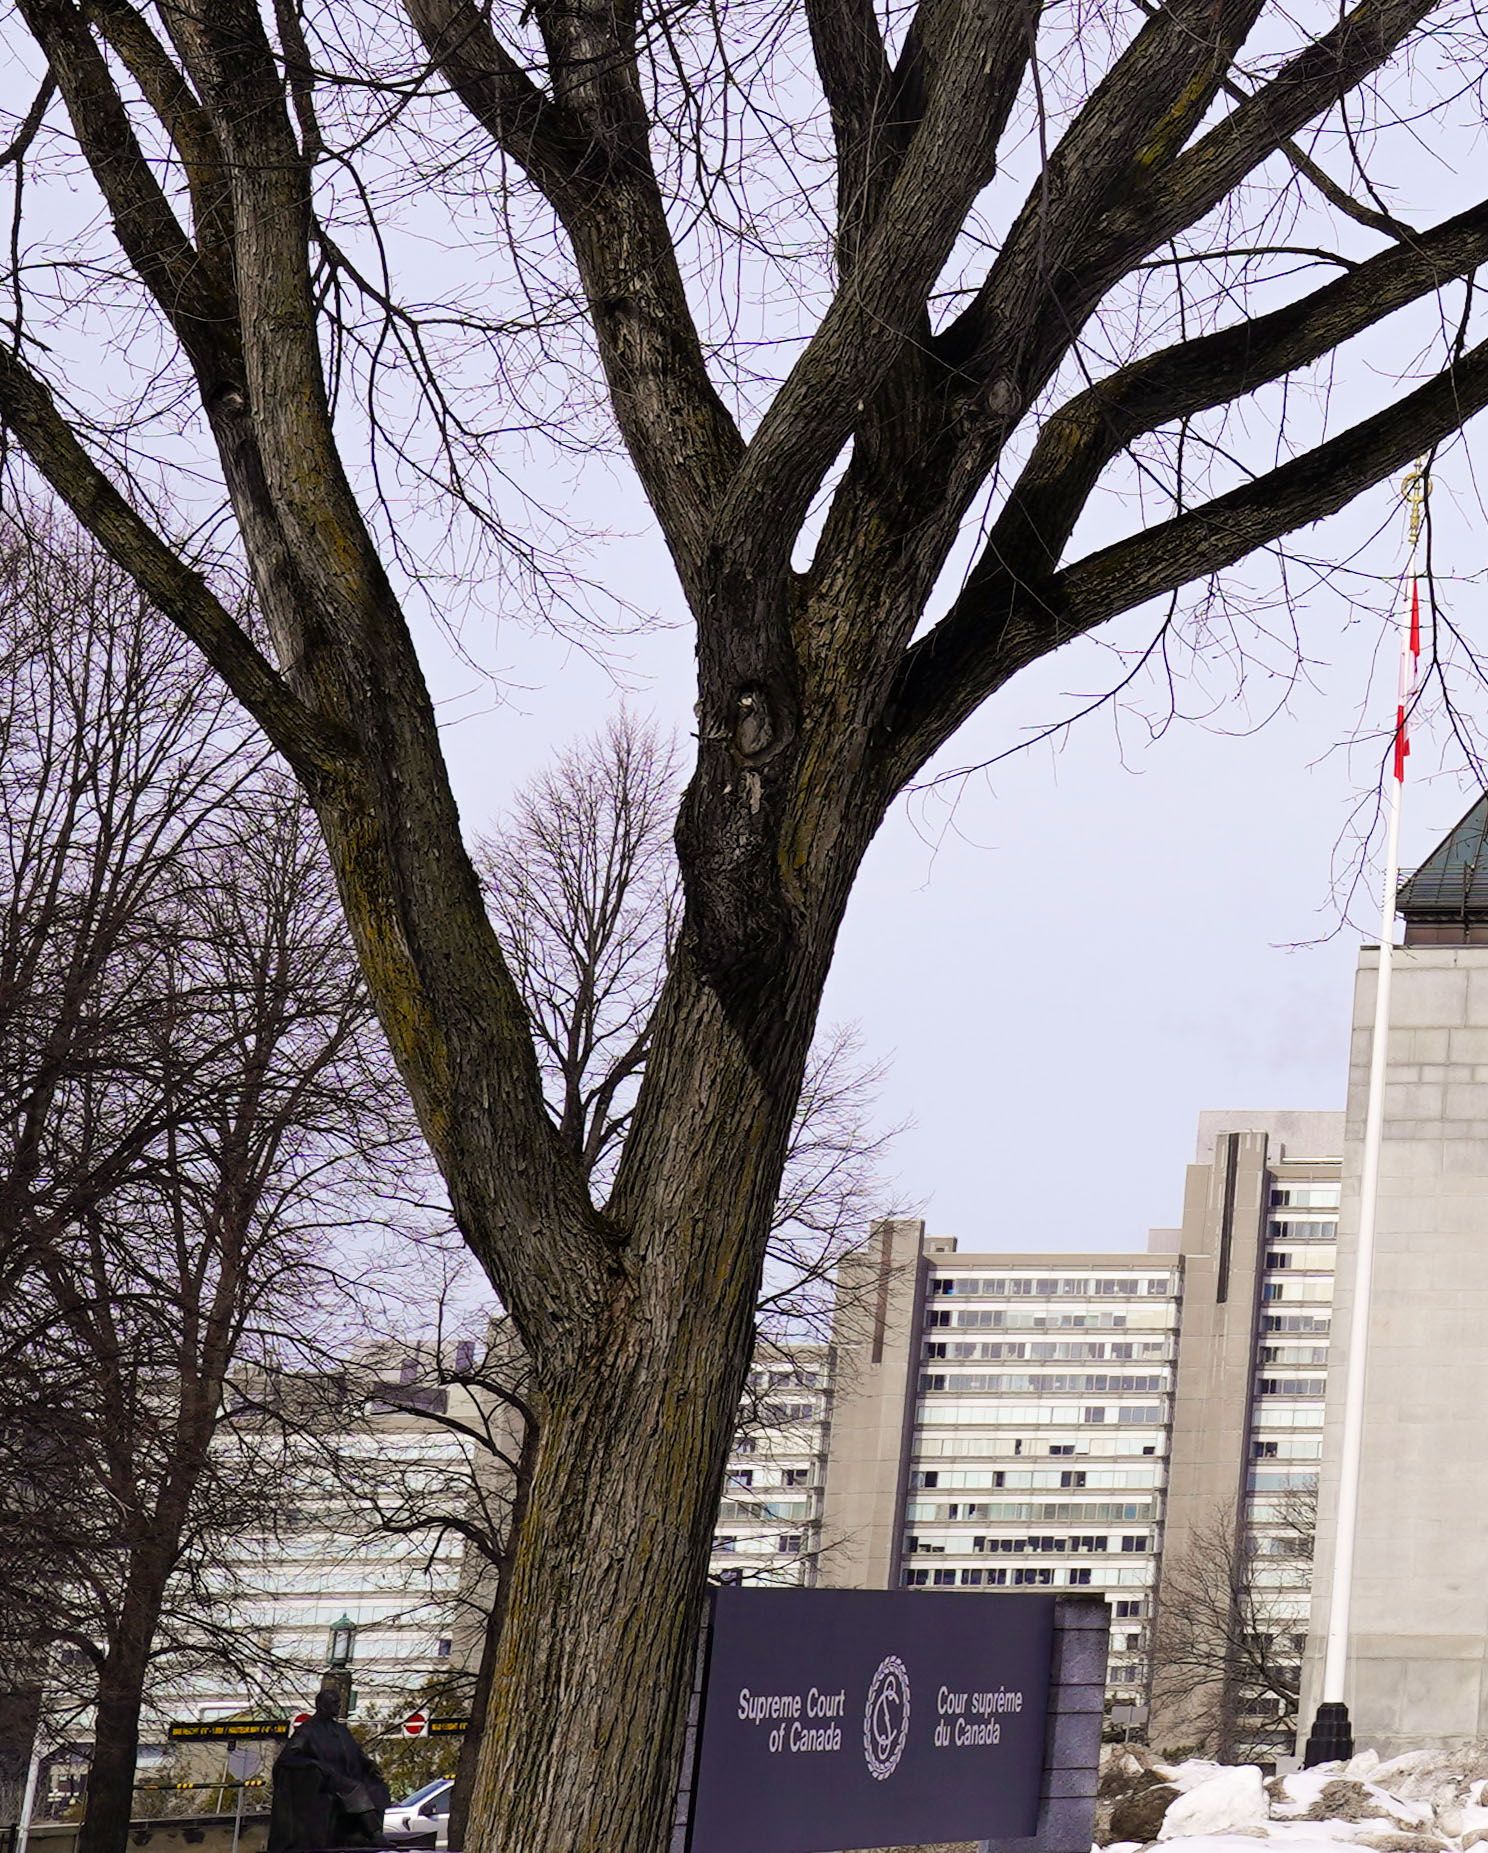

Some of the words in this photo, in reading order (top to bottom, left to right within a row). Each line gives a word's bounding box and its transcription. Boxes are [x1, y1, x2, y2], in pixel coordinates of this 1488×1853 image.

[738, 1688, 802, 1725] Supreme
[807, 1687, 845, 1719] Court
[937, 1686, 968, 1715] Cour
[971, 1686, 1023, 1719] suprême
[769, 1722, 787, 1752] of
[790, 1721, 841, 1752] Canada
[934, 1719, 951, 1747] du
[955, 1717, 1000, 1746] Canada
